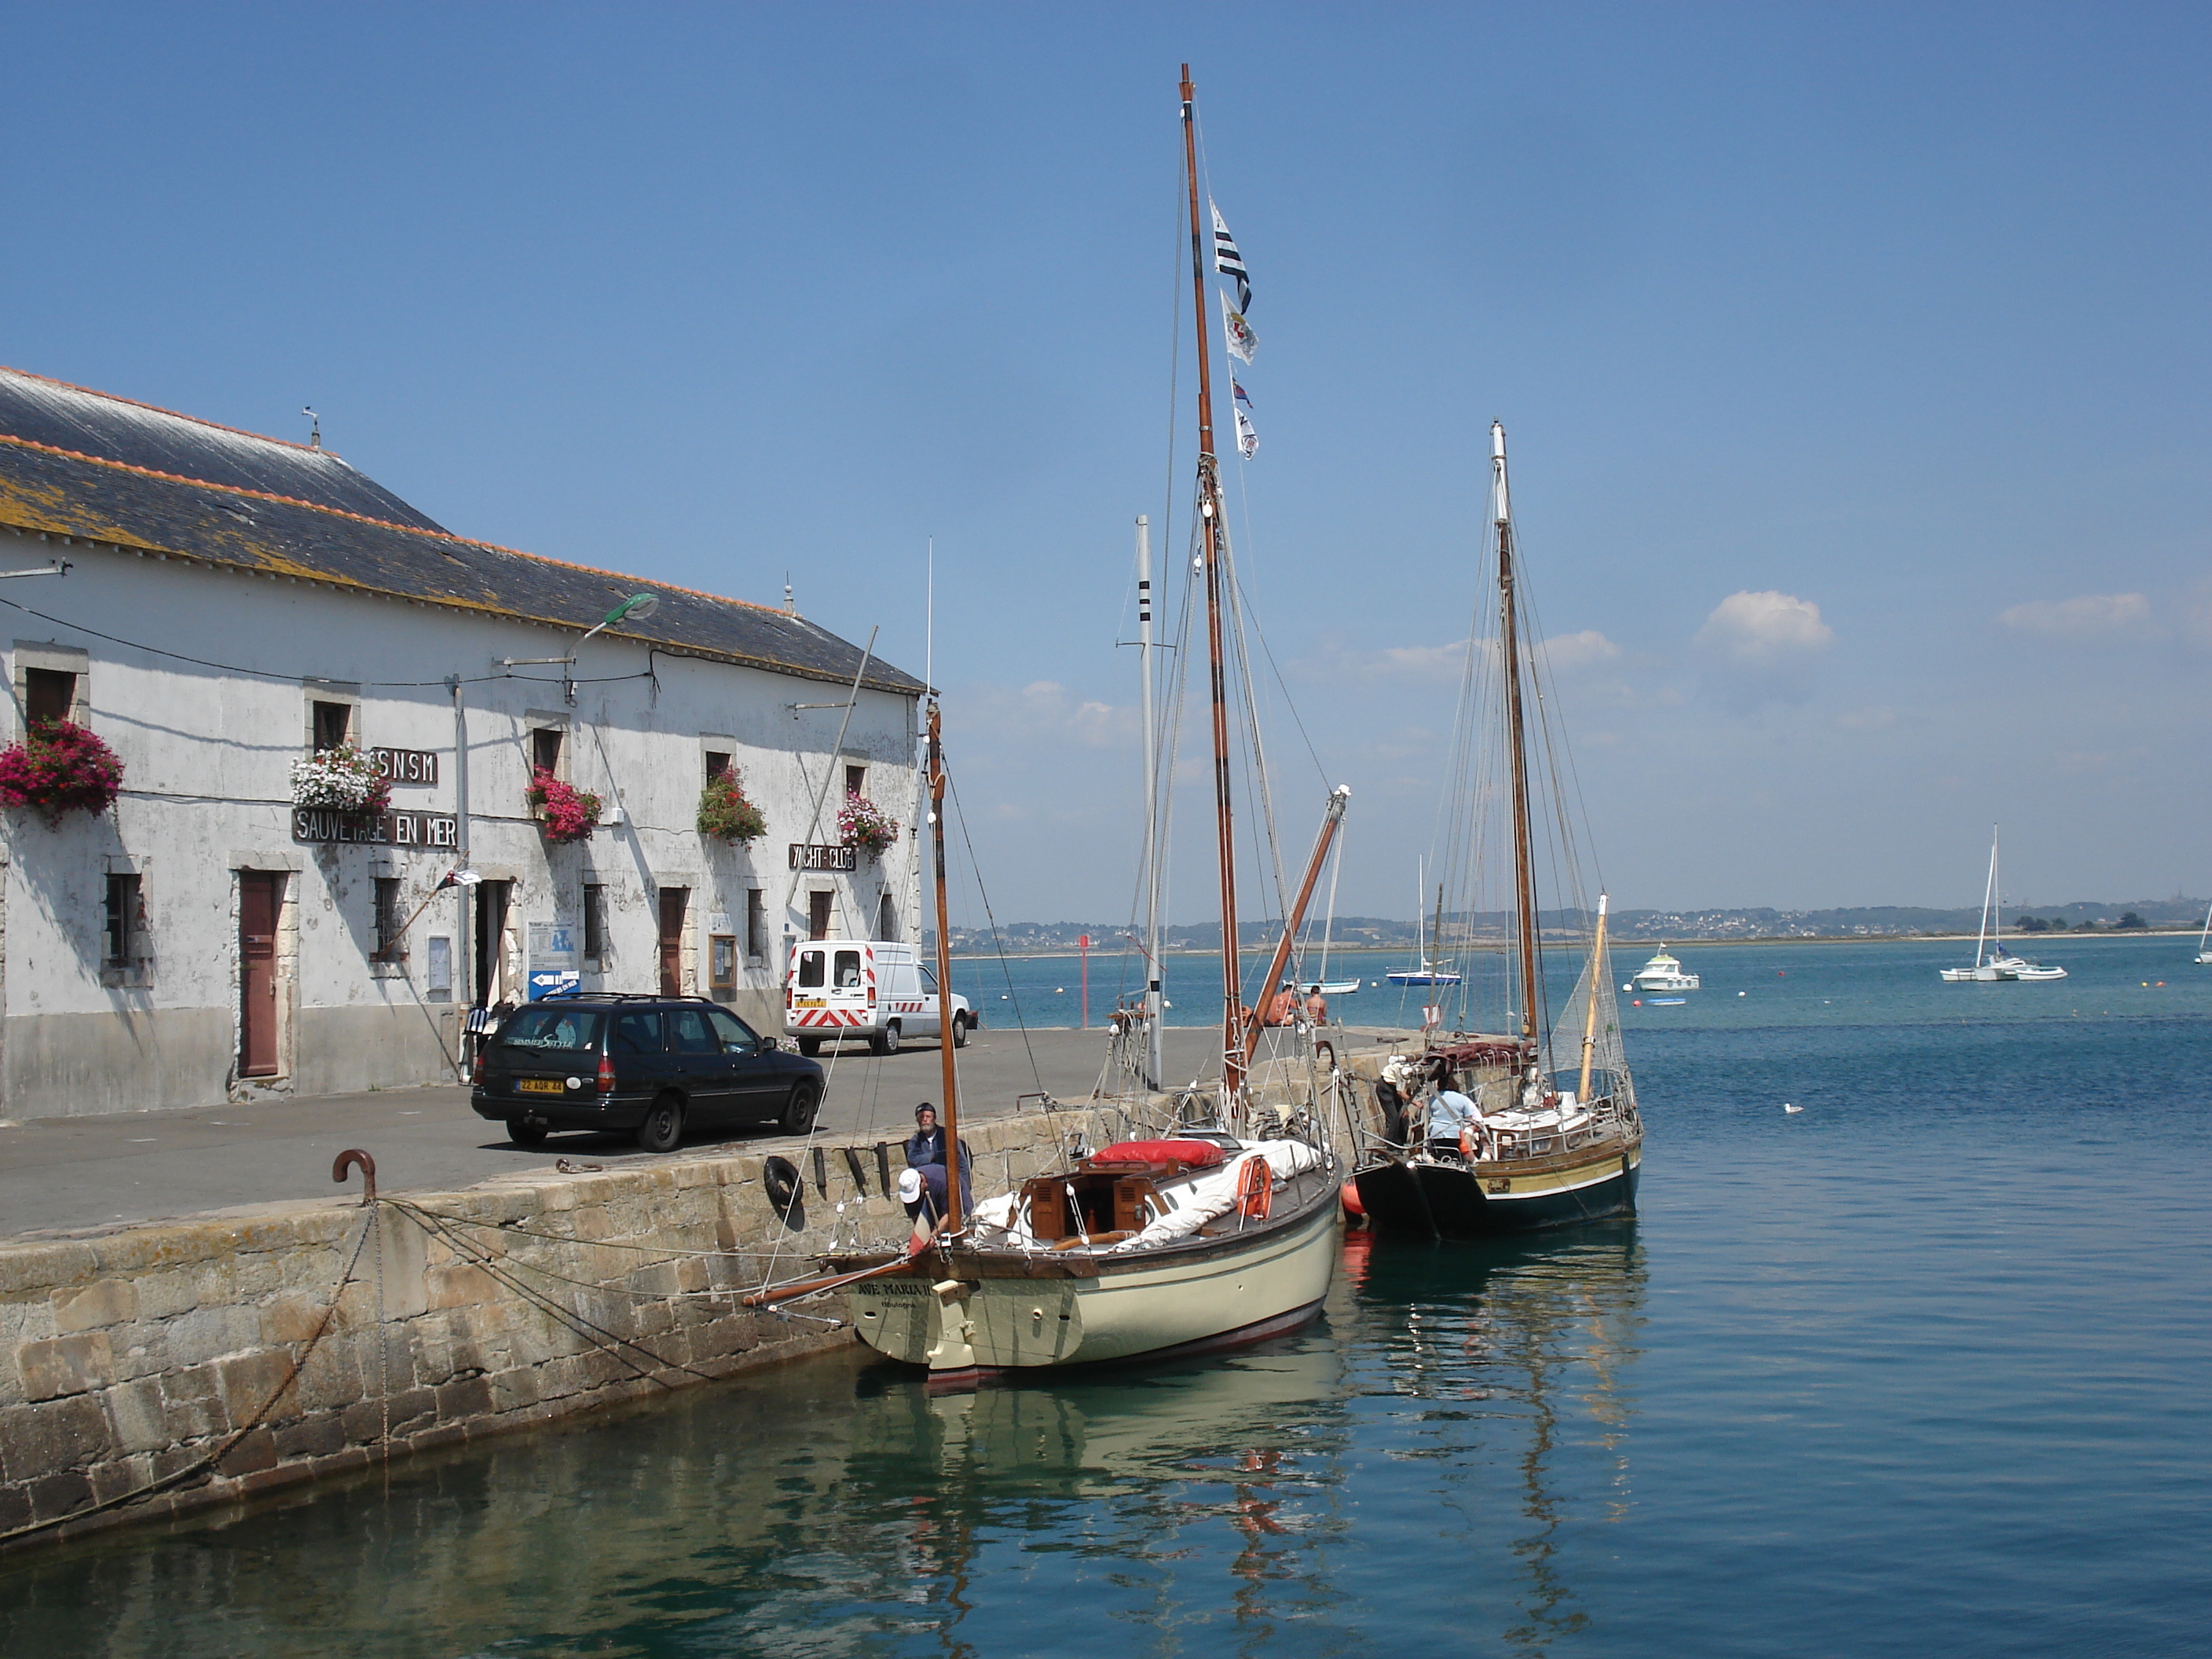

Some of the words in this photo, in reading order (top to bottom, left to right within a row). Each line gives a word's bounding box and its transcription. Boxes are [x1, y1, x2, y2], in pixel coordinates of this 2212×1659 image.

[377, 750, 434, 782] SNSM
[396, 816, 418, 844] EN
[427, 817, 456, 847] MER
[522, 1080, 532, 1090] 22
[551, 1082, 562, 1091] 44
[858, 1284, 881, 1295] AVE
[882, 1284, 922, 1295] MARIA
